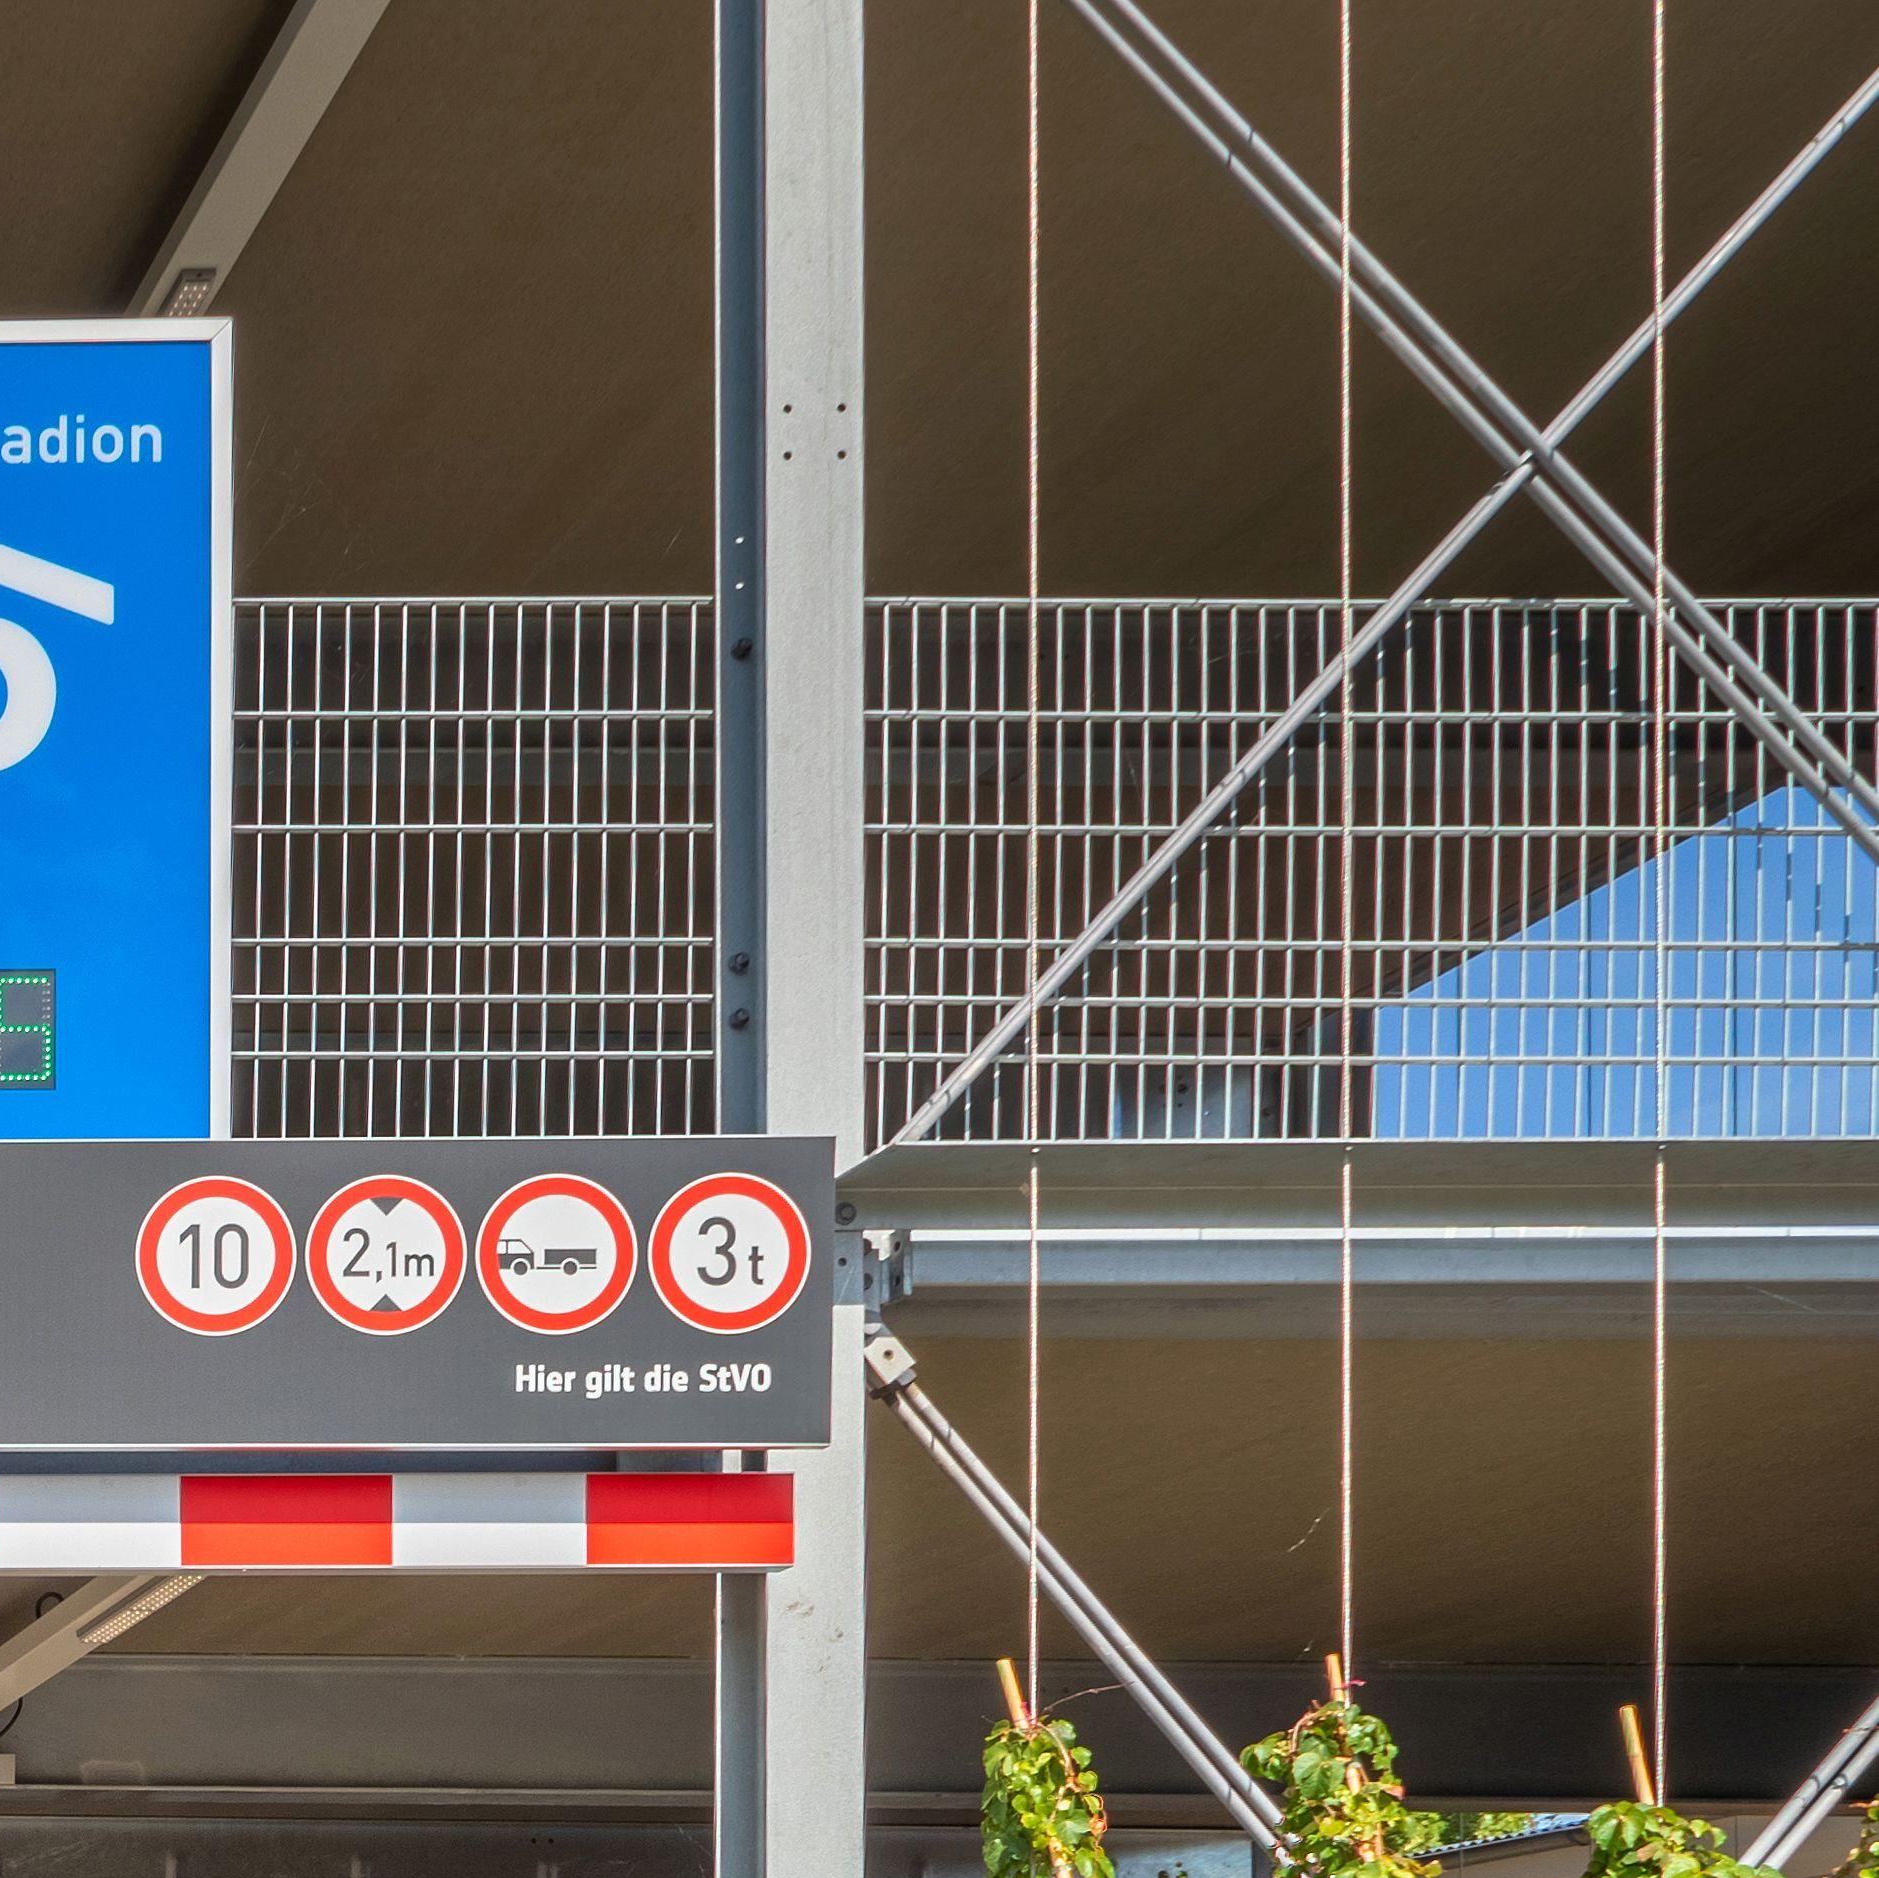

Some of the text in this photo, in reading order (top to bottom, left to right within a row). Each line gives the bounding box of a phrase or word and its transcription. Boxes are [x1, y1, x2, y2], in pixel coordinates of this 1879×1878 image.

[179, 1223, 249, 1289] 10
[697, 1216, 765, 1286] 3 t
[515, 1362, 773, 1399] Hier gilt die StVO
